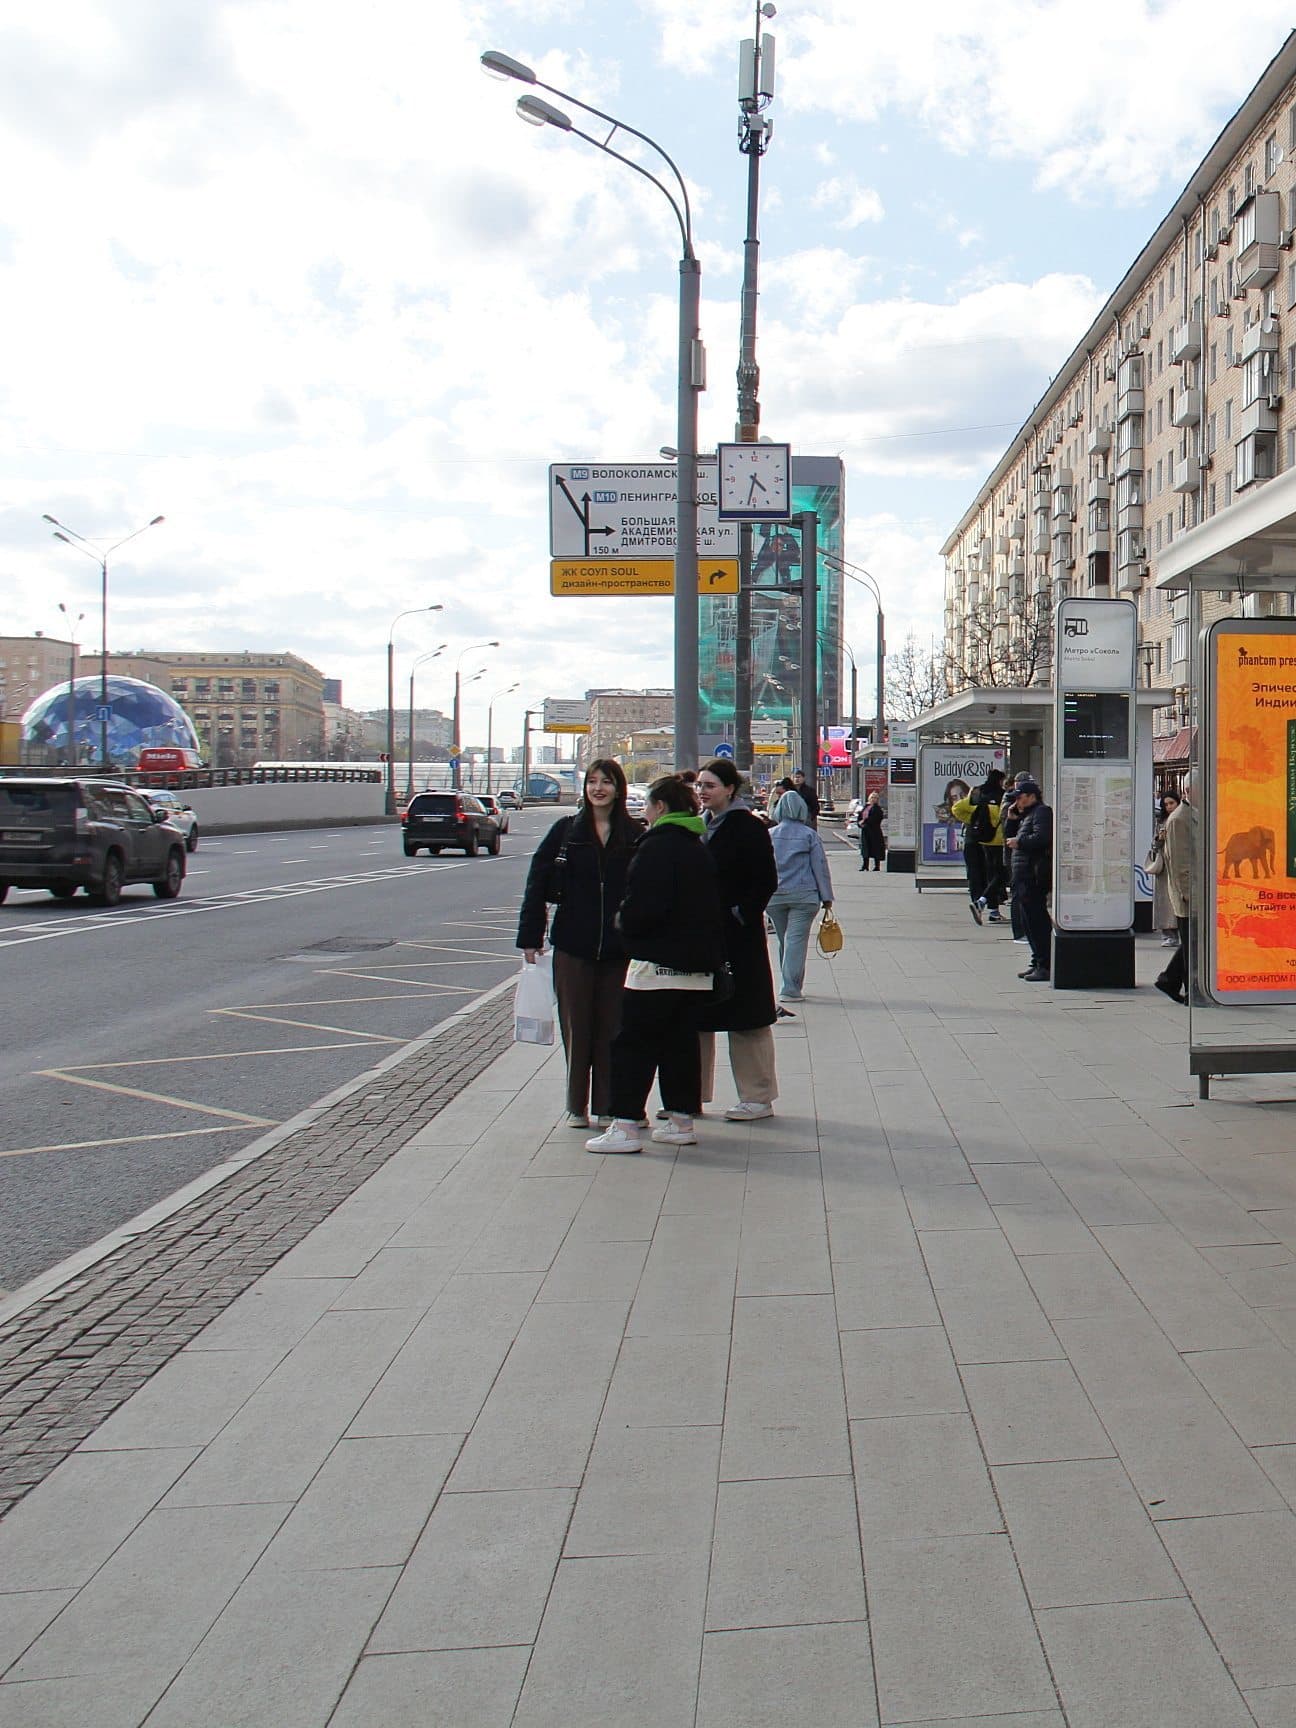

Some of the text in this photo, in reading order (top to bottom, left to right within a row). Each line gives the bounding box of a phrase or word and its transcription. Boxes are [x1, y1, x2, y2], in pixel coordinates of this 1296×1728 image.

[592, 470, 678, 478] ВОЛОКОЛАМСК
[619, 492, 717, 501] ЛЕНИНГРАКОЕ
[621, 517, 676, 526] БОЛЬШАЯ
[718, 528, 734, 537] ул.
[593, 546, 609, 554] 150
[562, 568, 639, 576] ЖК СОУЛ SOUL
[561, 579, 671, 589] дизайн-пространство
[1239, 655, 1277, 668] phantom
[1258, 890, 1274, 900] Во
[1245, 903, 1286, 911] Читайте
